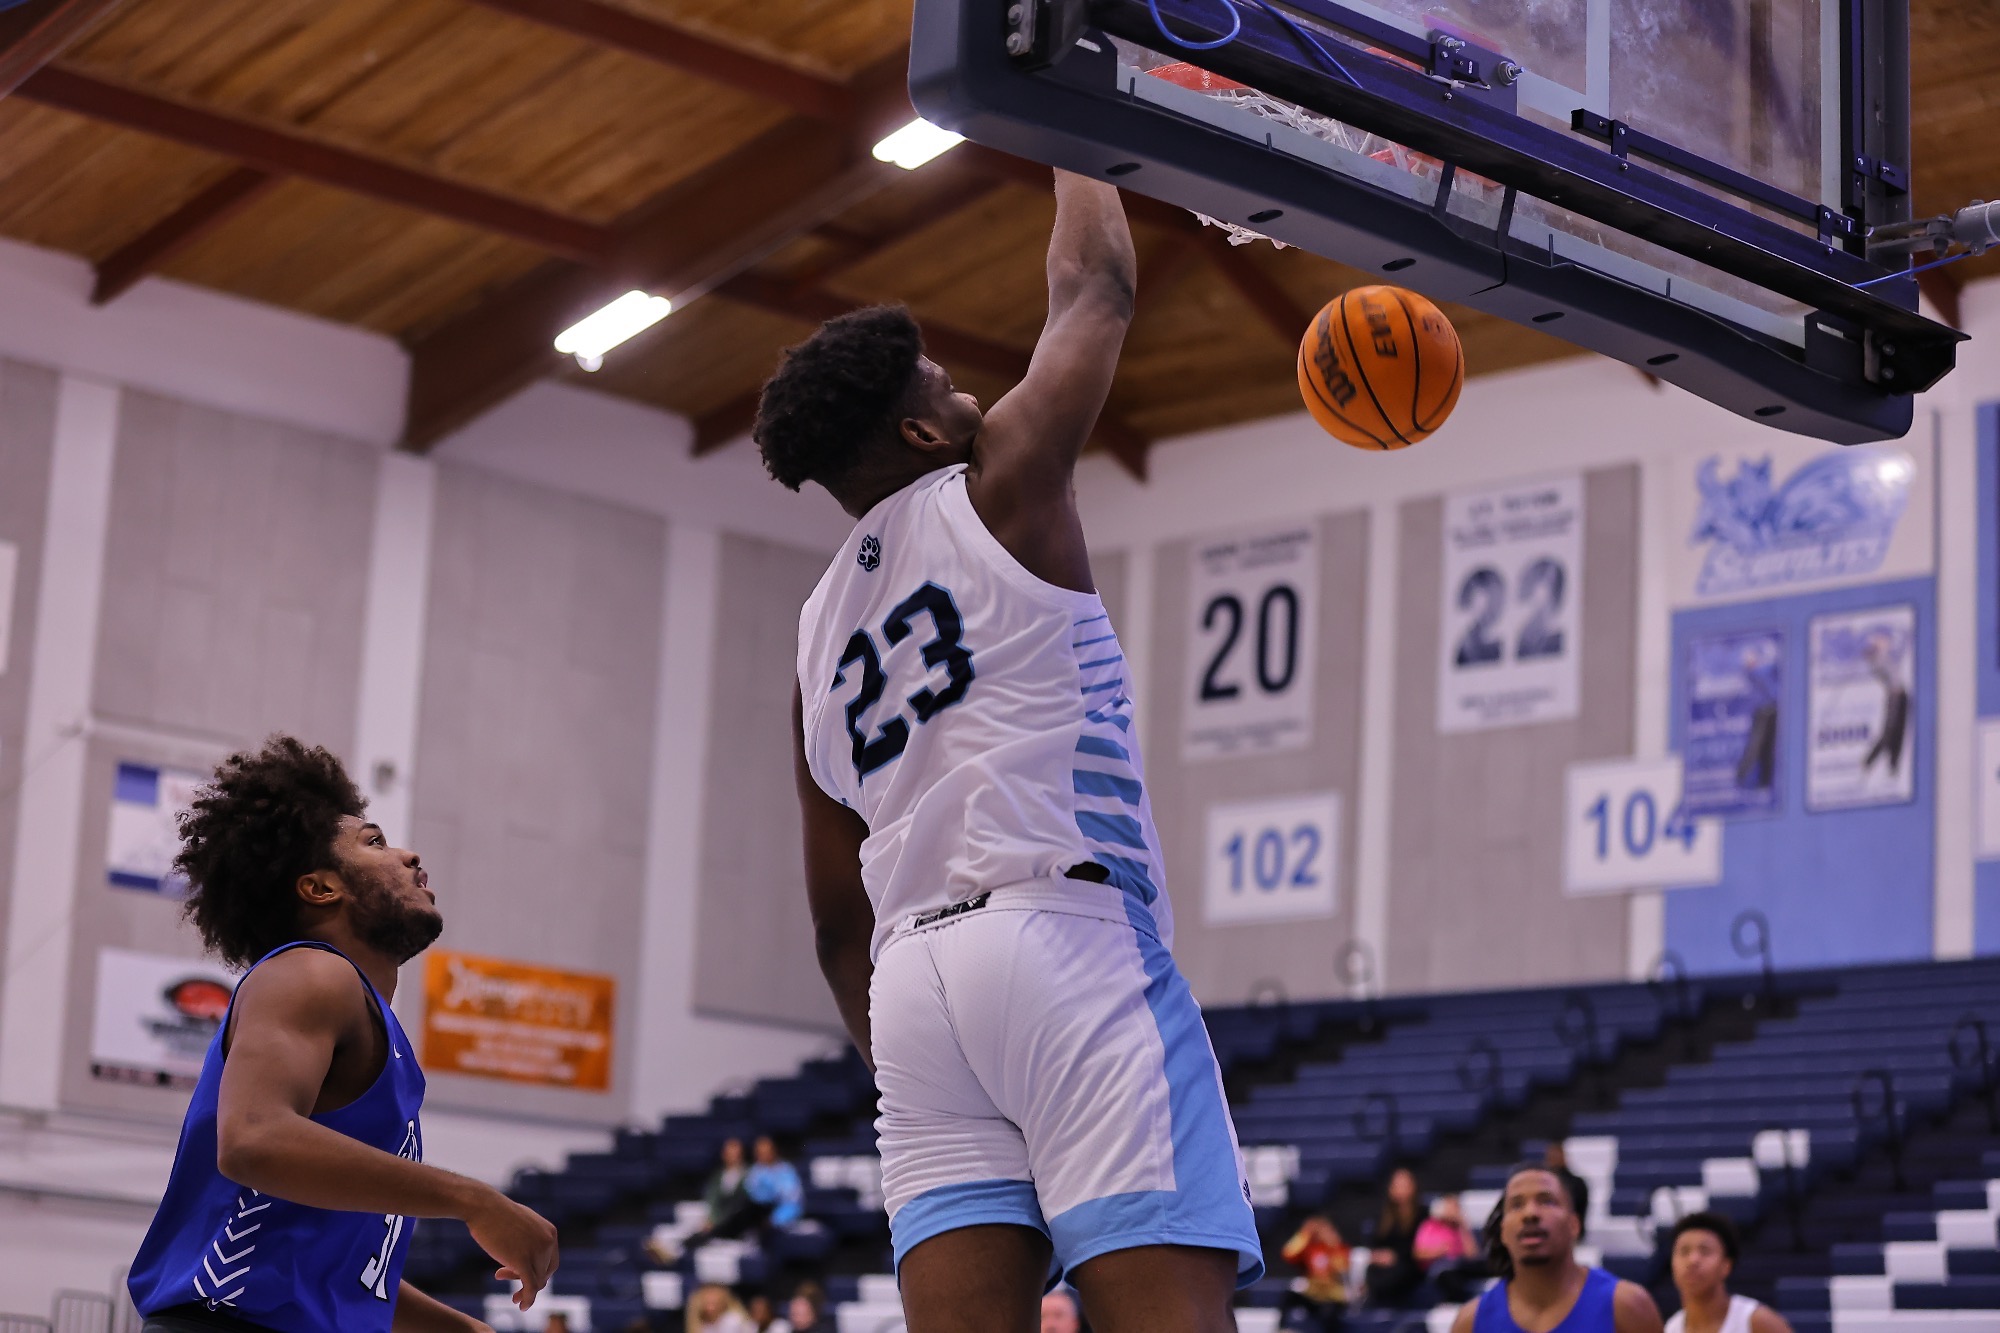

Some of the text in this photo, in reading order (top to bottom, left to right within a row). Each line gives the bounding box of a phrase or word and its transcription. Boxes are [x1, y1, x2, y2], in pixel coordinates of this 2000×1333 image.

[1200, 584, 1299, 700] 20
[1456, 556, 1566, 670] 22
[829, 580, 976, 788] 23
[1224, 823, 1322, 894] 102
